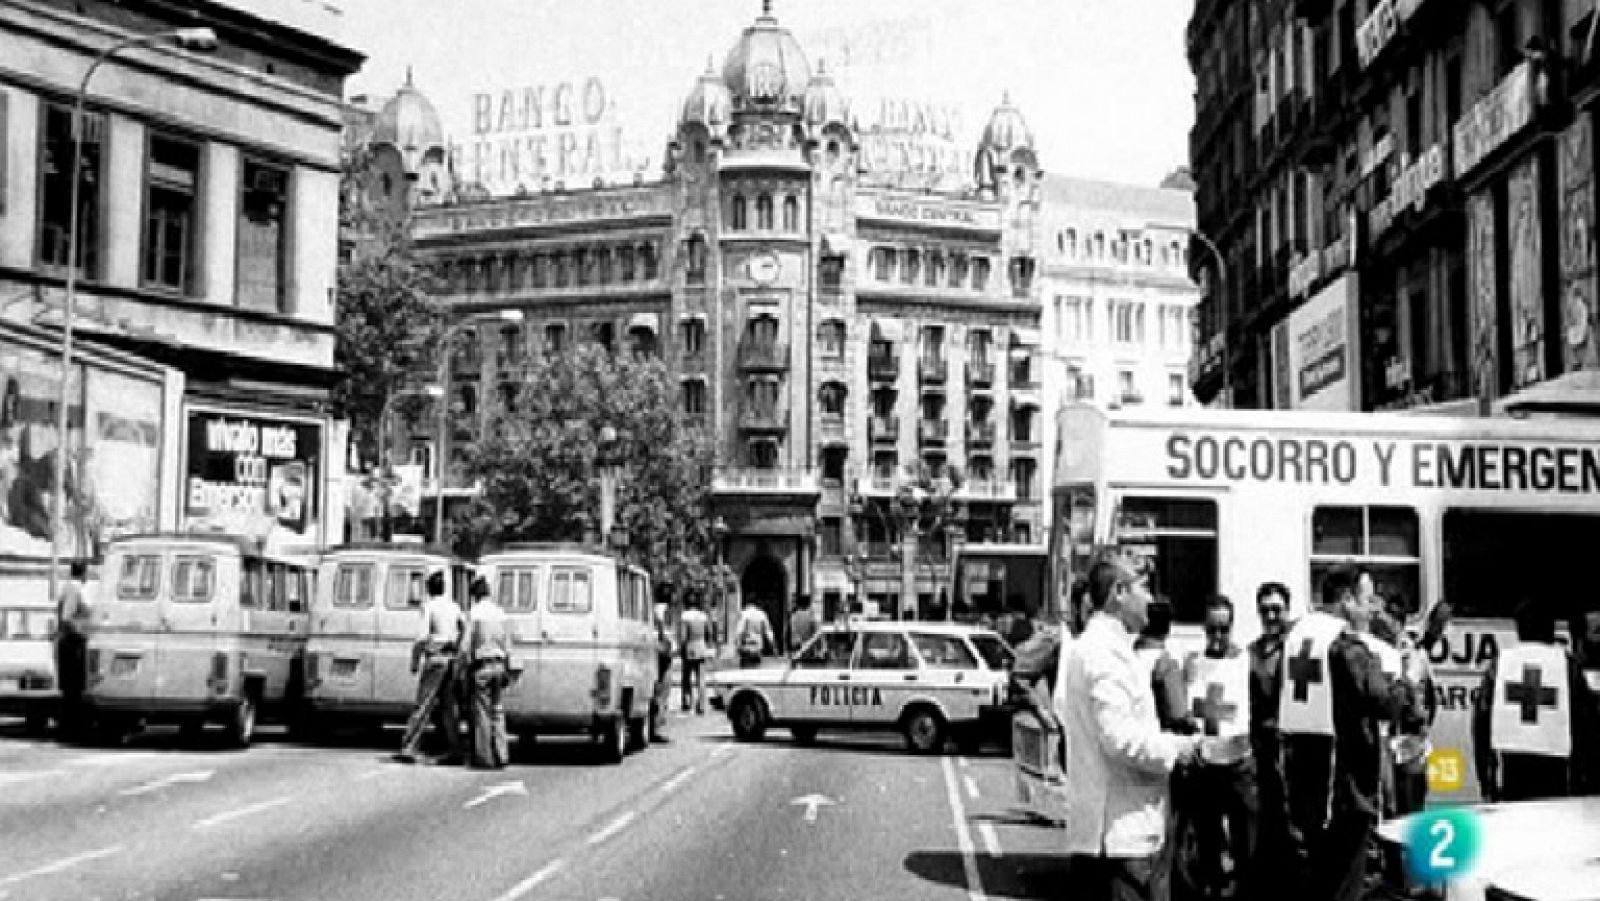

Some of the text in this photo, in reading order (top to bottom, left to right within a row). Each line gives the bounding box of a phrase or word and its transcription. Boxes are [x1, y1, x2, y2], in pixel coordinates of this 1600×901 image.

[473, 75, 605, 134] BANCO
[235, 457, 267, 483] con
[1166, 434, 1600, 494] SOCORRO Y EMERGEN
[809, 685, 882, 706] POLICIA
